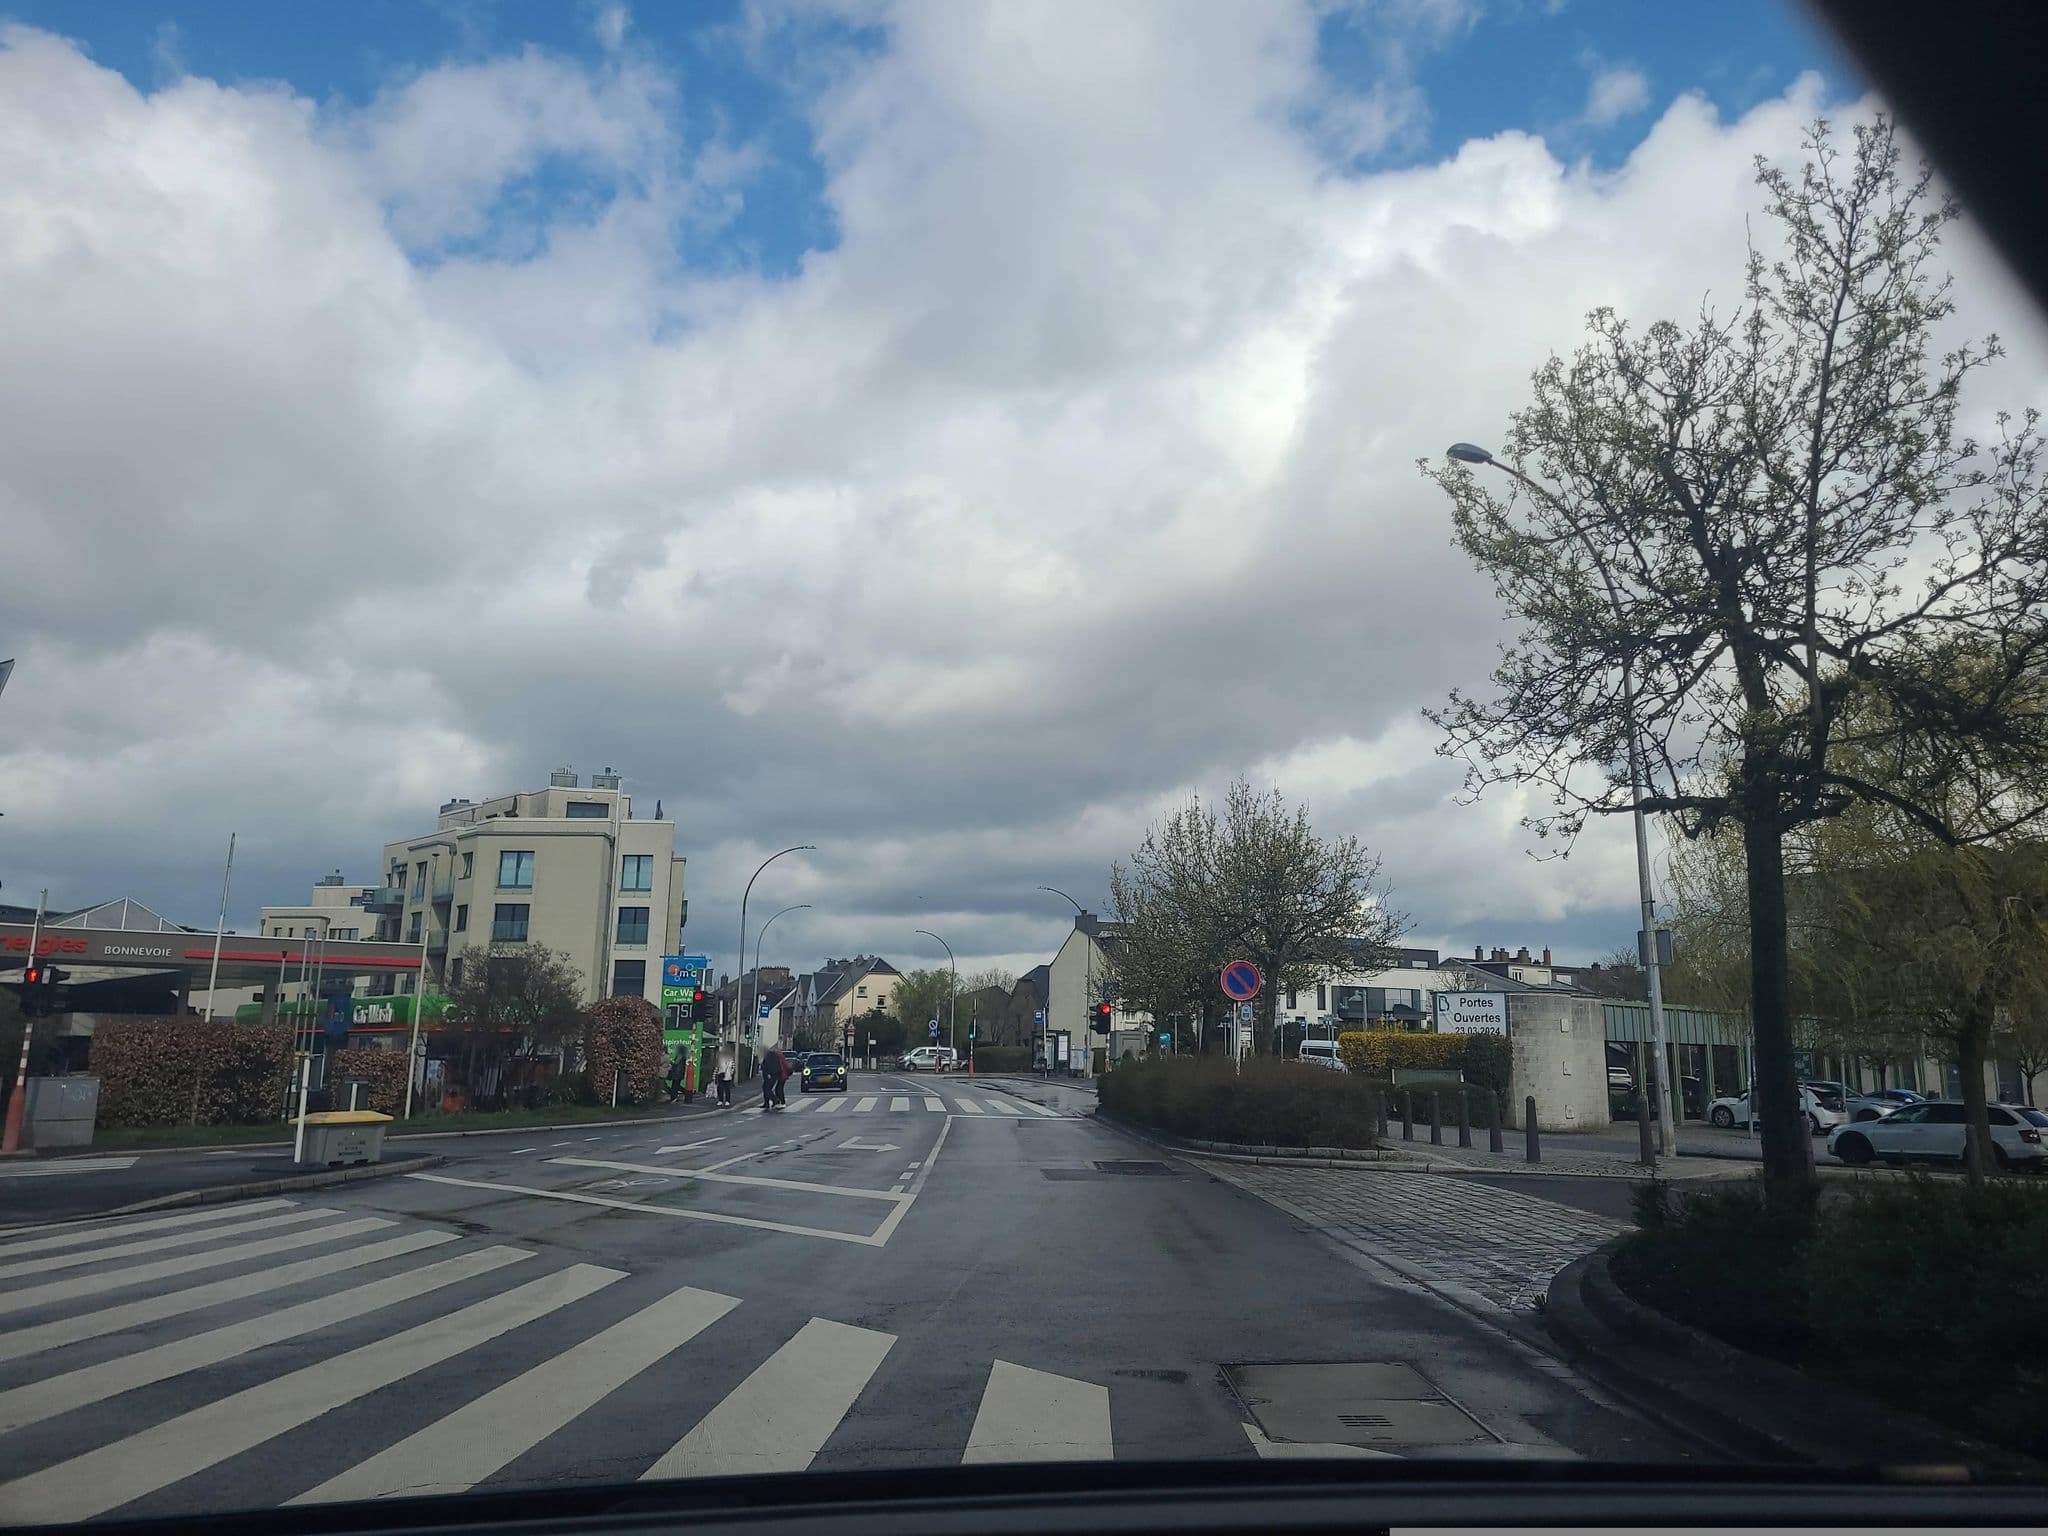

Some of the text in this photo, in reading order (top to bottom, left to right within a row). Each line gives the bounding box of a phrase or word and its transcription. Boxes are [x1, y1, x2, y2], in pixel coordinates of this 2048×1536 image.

[104, 945, 172, 957] BONNEVOIE
[664, 989, 693, 997] Car Wa
[1459, 997, 1494, 1008] Portes
[353, 1005, 368, 1024] Car
[1453, 1012, 1501, 1023] Ouvertes
